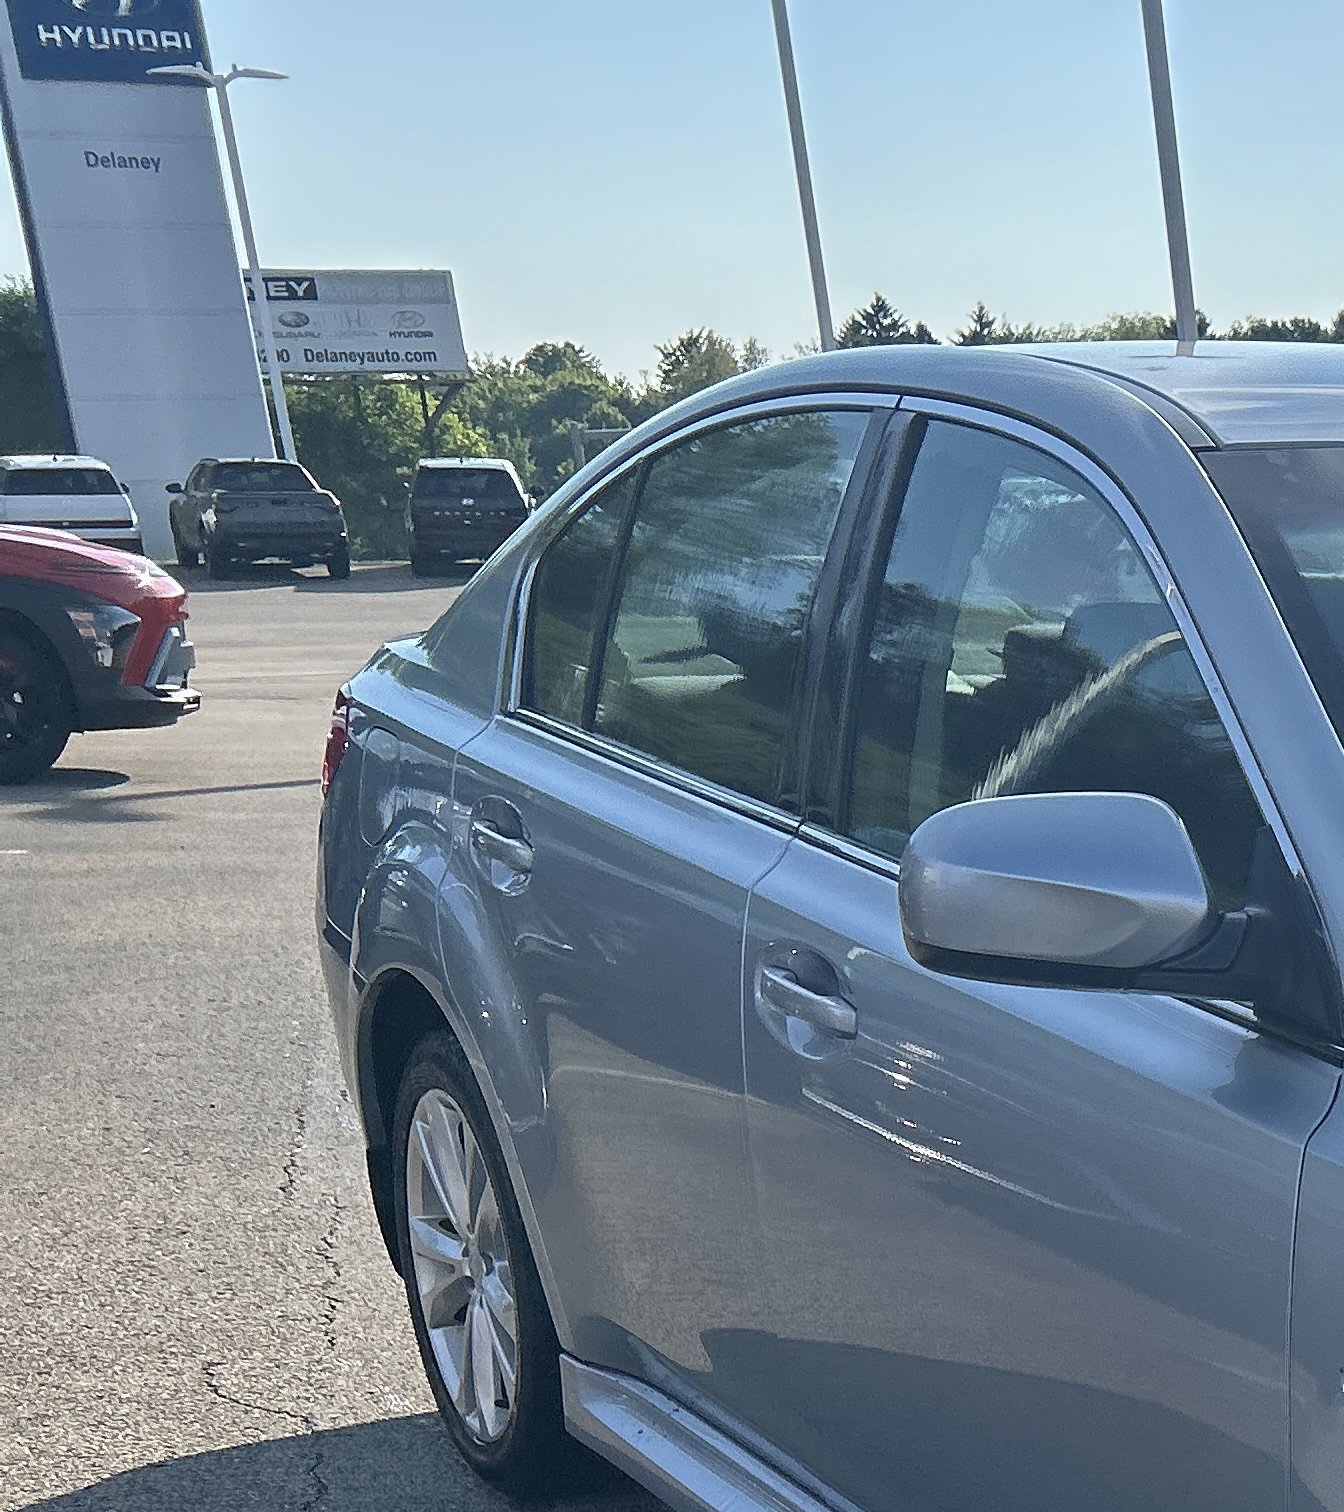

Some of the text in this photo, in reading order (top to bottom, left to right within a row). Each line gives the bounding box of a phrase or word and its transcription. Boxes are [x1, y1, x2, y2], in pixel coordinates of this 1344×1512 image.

[37, 24, 193, 52] HYUNDAI
[83, 150, 162, 173] Delaney
[388, 330, 434, 339] HYUNDAI
[303, 348, 438, 366] Delaneyauto.com
